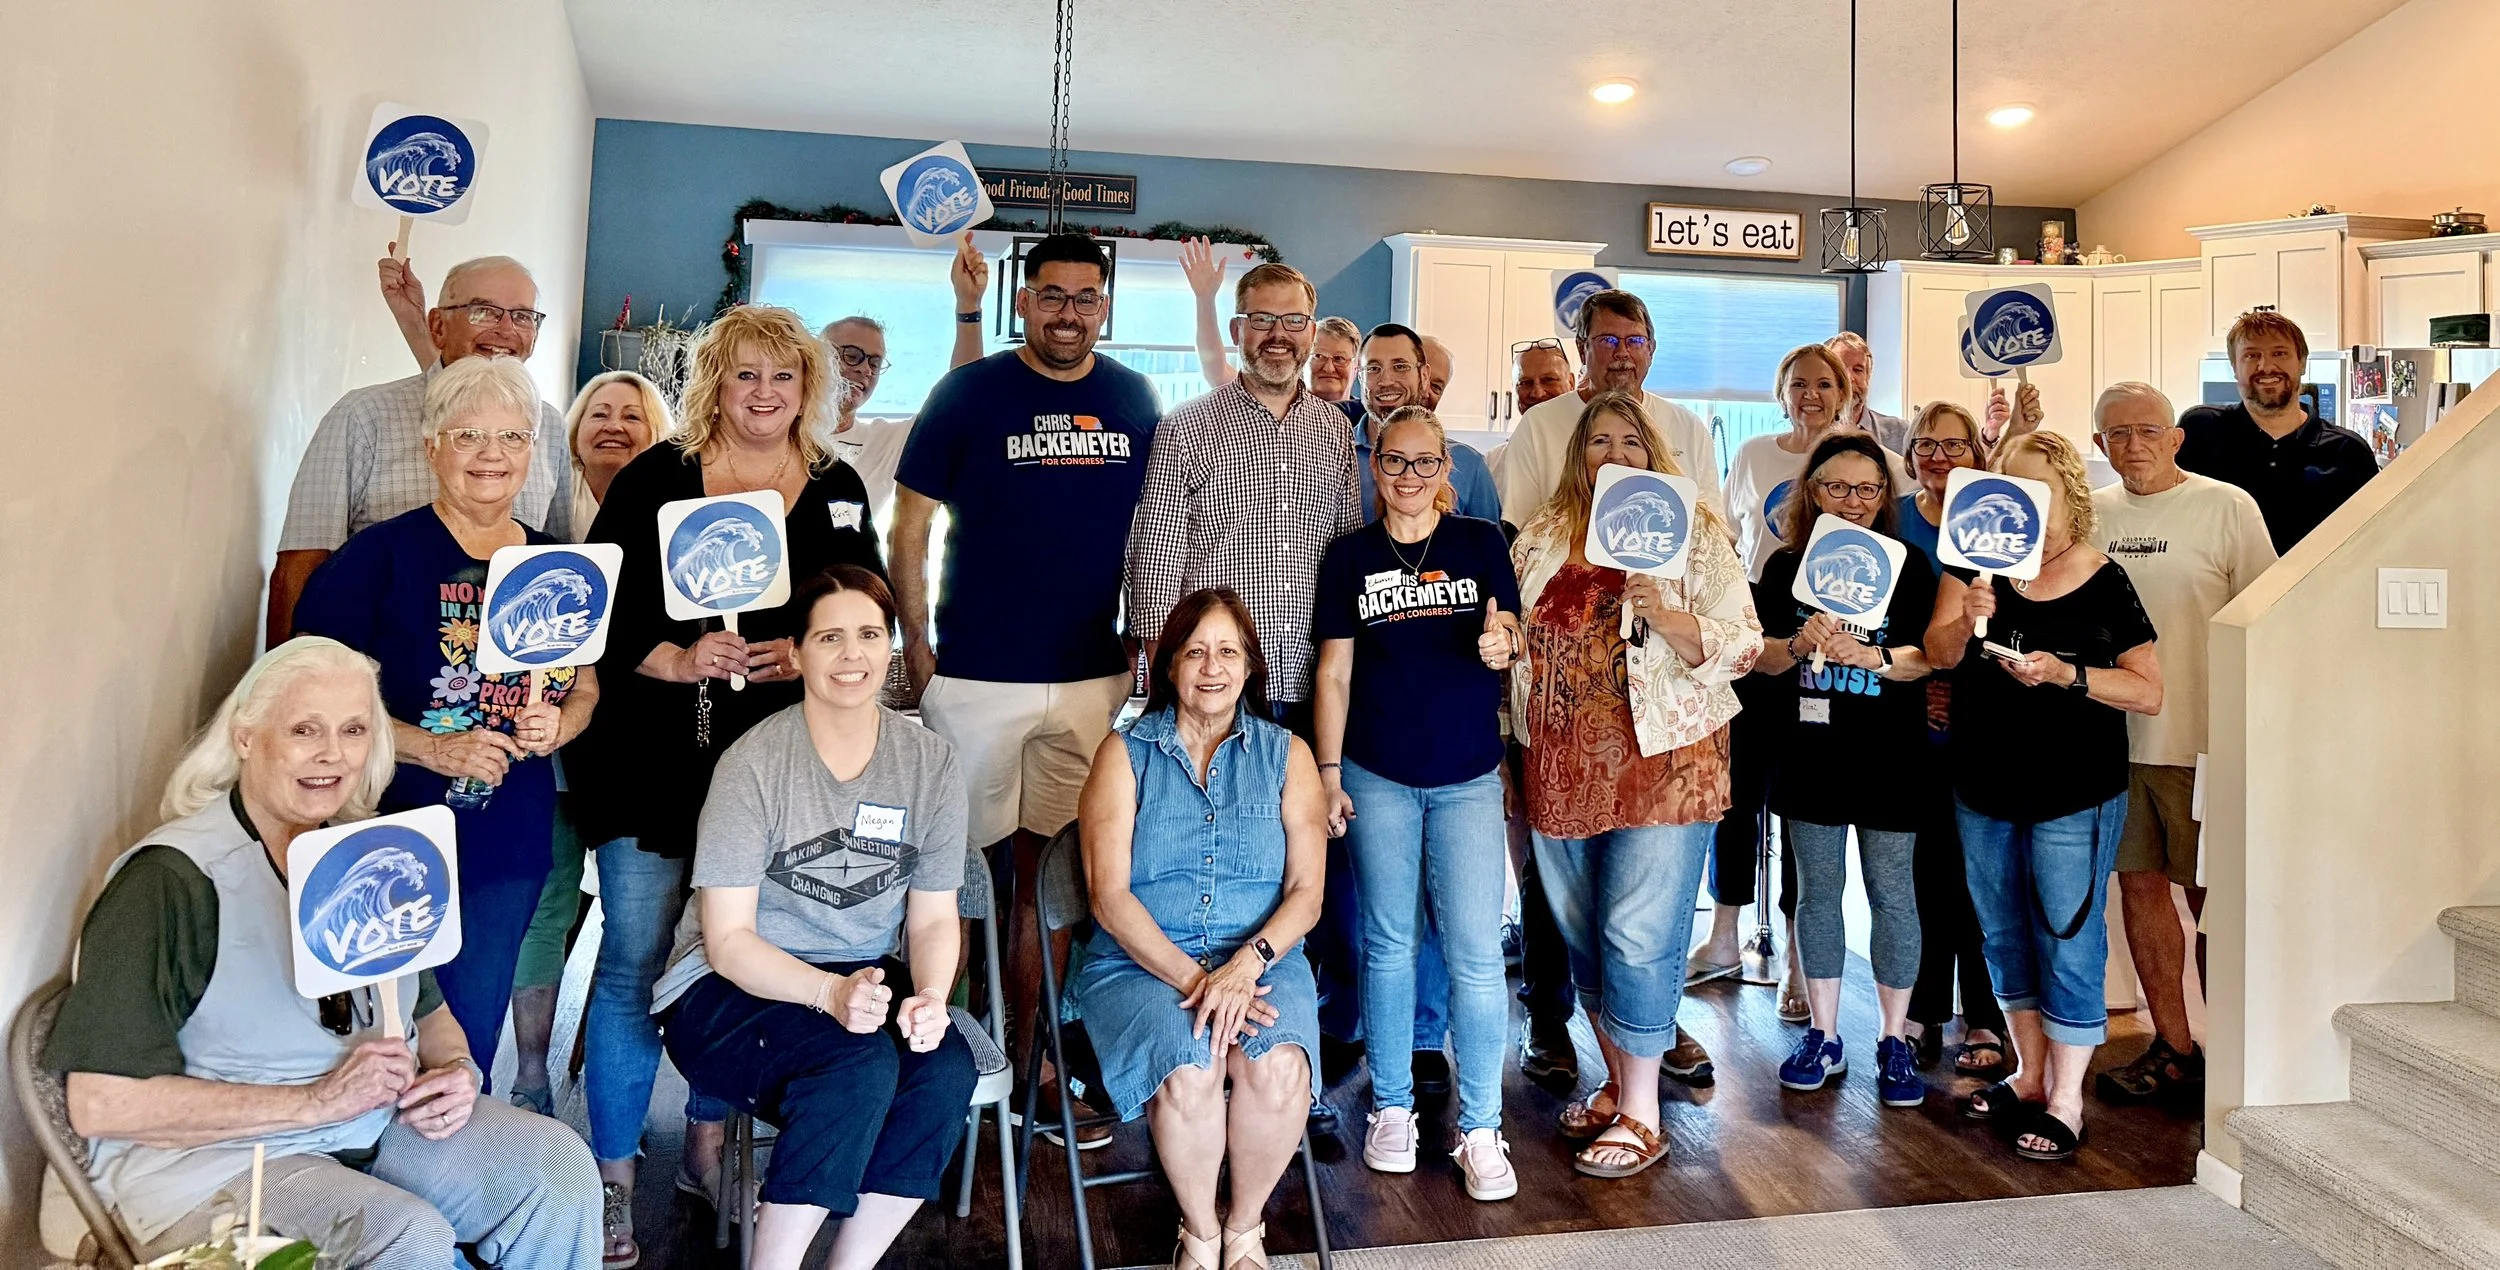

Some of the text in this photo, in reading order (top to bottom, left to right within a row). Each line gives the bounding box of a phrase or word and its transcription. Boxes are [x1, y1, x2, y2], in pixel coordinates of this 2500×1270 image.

[380, 167, 459, 197] VOTE
[979, 177, 1006, 197] ood
[1063, 182, 1092, 202] Good
[1096, 183, 1130, 204] Times
[917, 186, 974, 232] VOTE
[1654, 211, 1795, 250] let's eat
[1987, 327, 2048, 357] VOTE
[1034, 414, 1072, 432] CHRIS
[1007, 432, 1131, 459] BACKEMEYER
[1041, 457, 1105, 466] FOR CONGRESS
[1606, 527, 1675, 553] VOTE
[1957, 527, 2028, 554] VOTE
[685, 554, 769, 599] VOTE
[1814, 569, 1878, 604] VOTE
[440, 582, 474, 603] NO
[1358, 578, 1479, 621] BACKEMEYER
[440, 601, 461, 618] IN
[1388, 607, 1453, 623] FOR CONGRESS
[503, 608, 591, 652] VOTE
[1799, 662, 1881, 697] HOUSE
[479, 682, 567, 706] PROTCT
[860, 814, 895, 831] Megan
[784, 841, 822, 868] MAKING
[840, 828, 901, 859] CNNECTION
[324, 894, 435, 964] VOTE
